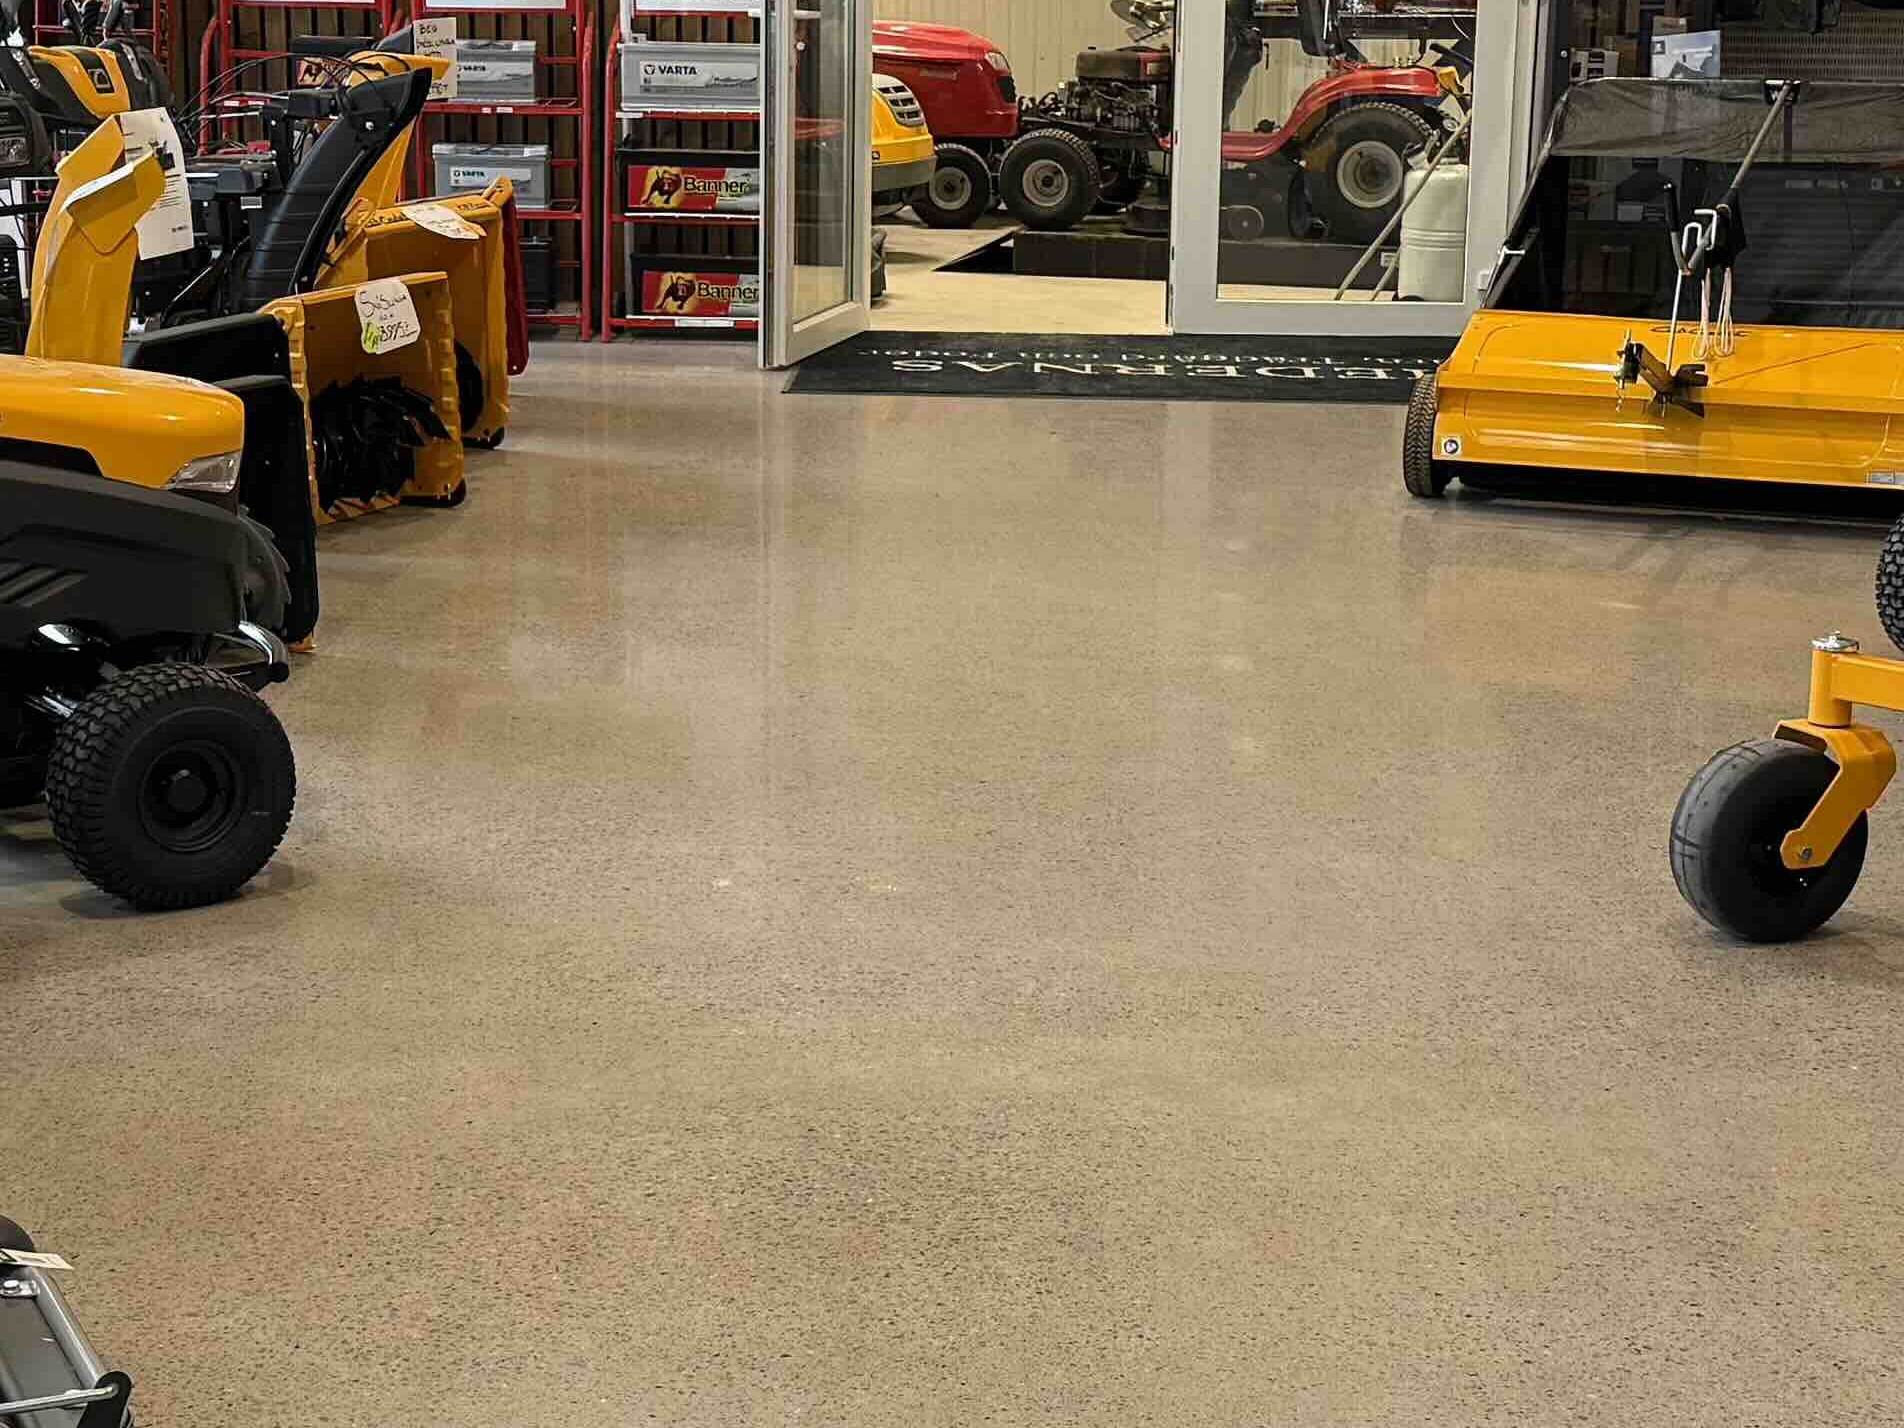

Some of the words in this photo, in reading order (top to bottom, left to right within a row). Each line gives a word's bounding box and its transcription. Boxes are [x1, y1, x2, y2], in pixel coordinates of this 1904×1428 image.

[658, 65, 698, 75] VARTA
[683, 176, 747, 193] Banner
[697, 282, 759, 299] Banner
